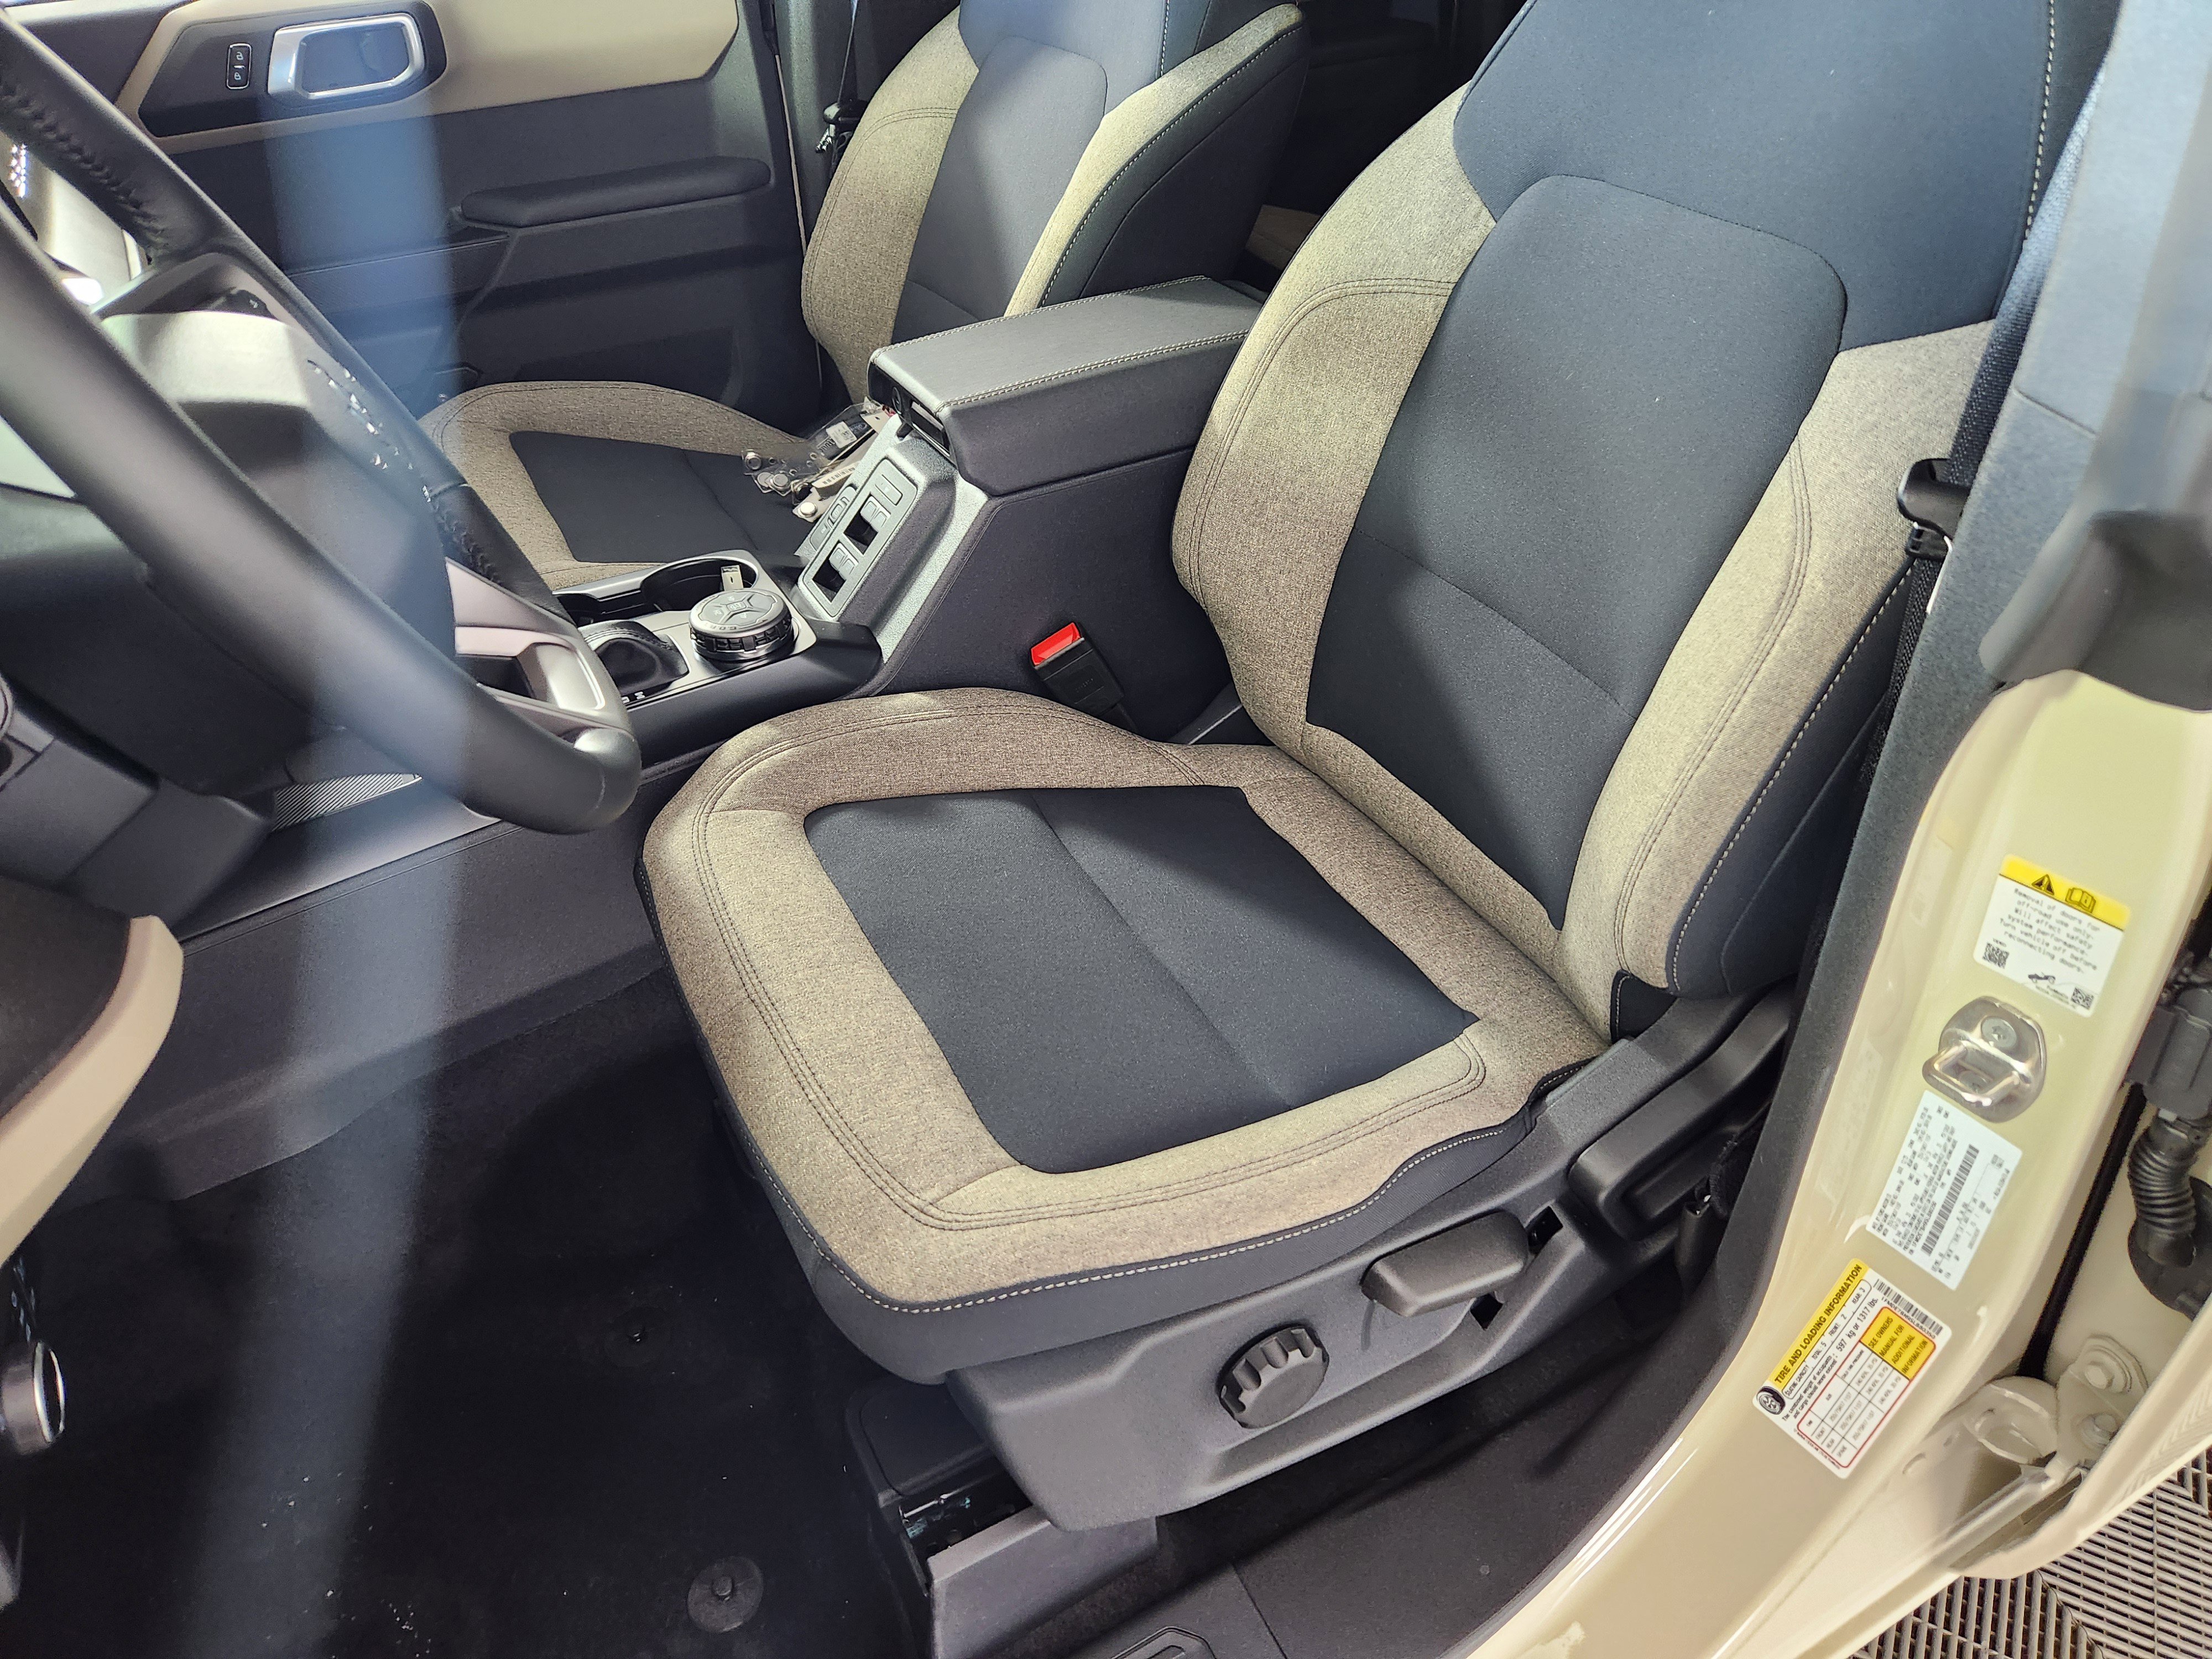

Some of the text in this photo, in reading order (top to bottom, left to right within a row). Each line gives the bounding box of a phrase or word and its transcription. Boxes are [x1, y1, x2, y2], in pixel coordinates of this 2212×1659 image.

[2007, 913, 2033, 931] system
[2013, 888, 2100, 933] Removal of doors for
[2013, 906, 2094, 951] Will affect safety
[2016, 898, 2052, 920] off-road
[2054, 917, 2069, 928] use
[1999, 917, 2017, 931] Turn
[2019, 927, 2050, 947] vehicle
[2052, 943, 2066, 955] off
[2069, 952, 2098, 971] before
[2003, 930, 2056, 961] reconnecting
[1774, 1263, 1864, 1385] TIRE AND LOADING INFORMATION
[1835, 1295, 1879, 1352] 597 kg or 1317 lbs.
[1878, 1323, 1905, 1357] MANUAL FOR
[1867, 1337, 1878, 1349] SEE
[1890, 1333, 1915, 1364] ADDITIONAL
[1900, 1338, 1929, 1374] INFORMATION
[1784, 1380, 1798, 1396] SEATING
[1795, 1364, 1810, 1383] CAPACITY
[1788, 1393, 1804, 1413] combined
[1802, 1380, 1814, 1395] weight
[1815, 1354, 1833, 1376] occupants
[1792, 1358, 1837, 1419] and cargo should never exceed
